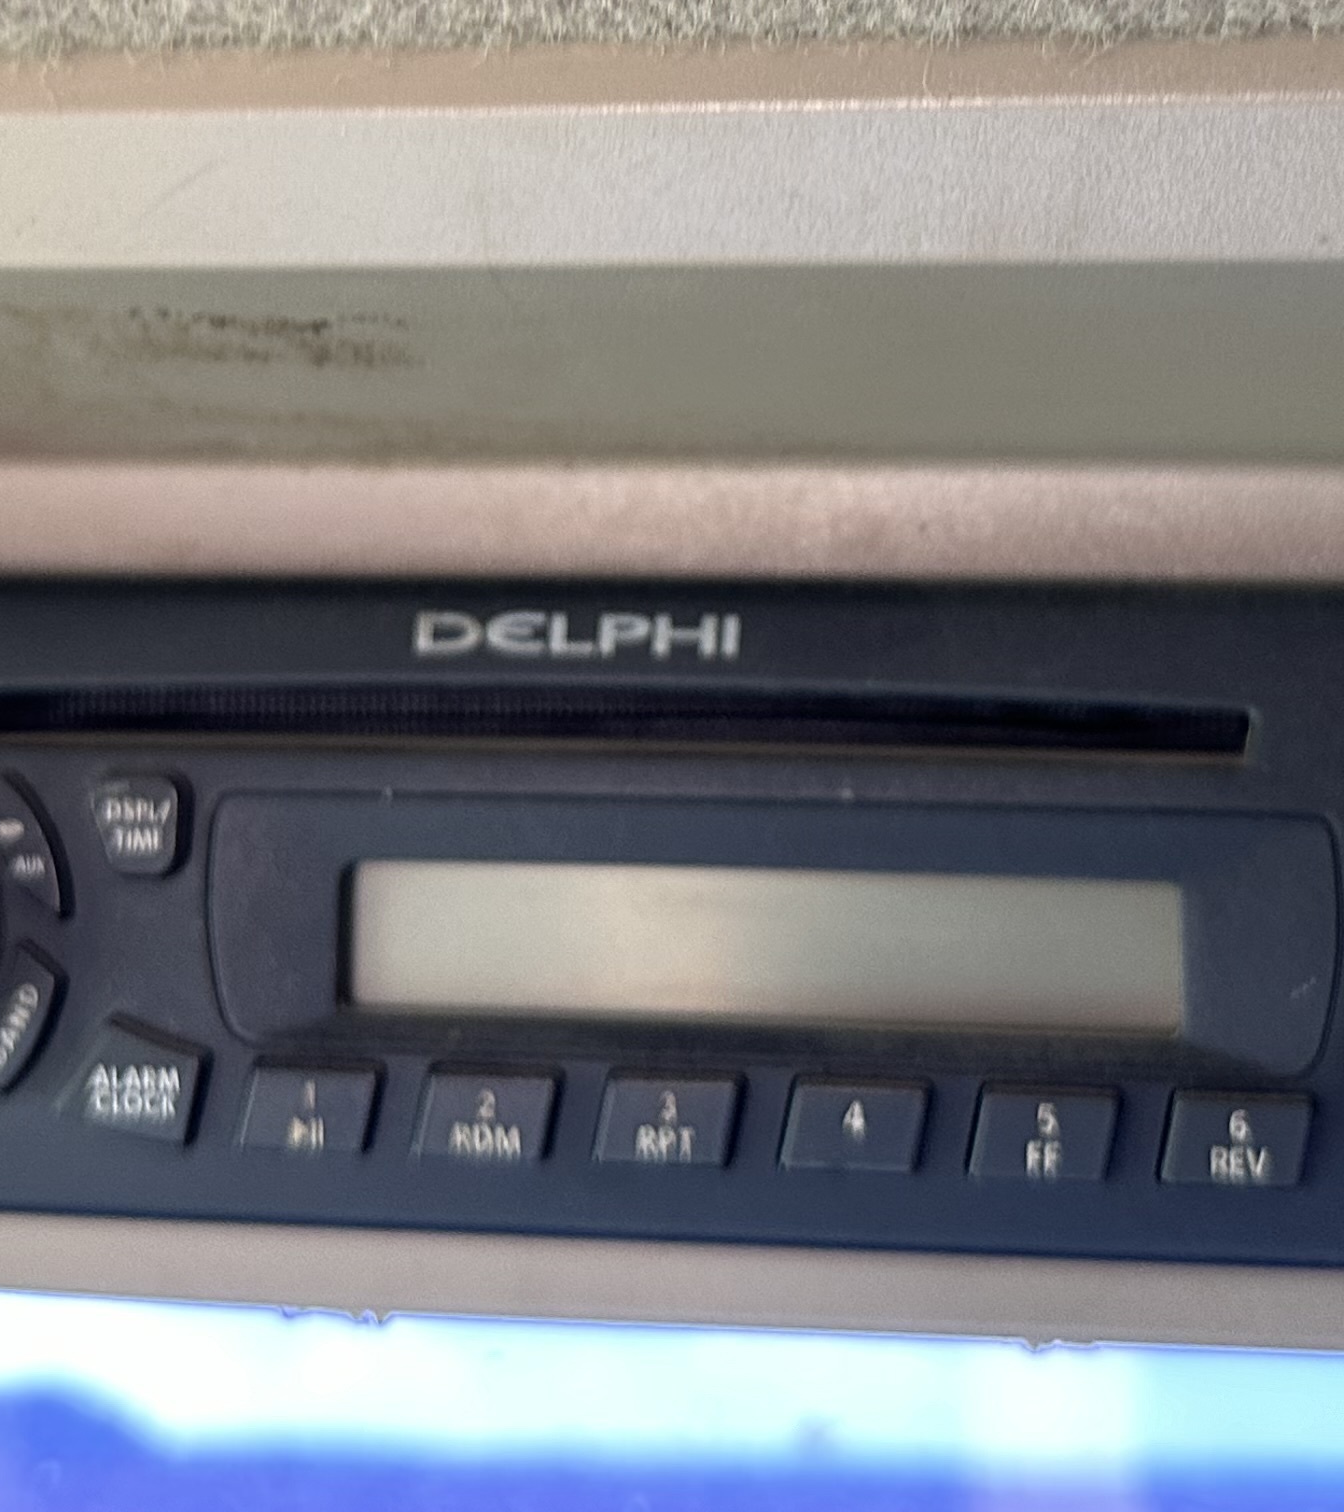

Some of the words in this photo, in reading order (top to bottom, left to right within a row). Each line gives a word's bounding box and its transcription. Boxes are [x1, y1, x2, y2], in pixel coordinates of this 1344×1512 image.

[412, 611, 742, 659] DELPHI
[87, 1062, 181, 1093] ALARM
[92, 1091, 177, 1120] CLOCK
[476, 1088, 497, 1118] 2
[842, 1099, 867, 1139] 4
[1036, 1102, 1060, 1136] 5
[449, 1120, 522, 1159] RDM
[634, 1123, 695, 1163] RPT
[1228, 1108, 1252, 1141] 6
[1025, 1139, 1063, 1179] FF
[1209, 1144, 1272, 1183] REV
